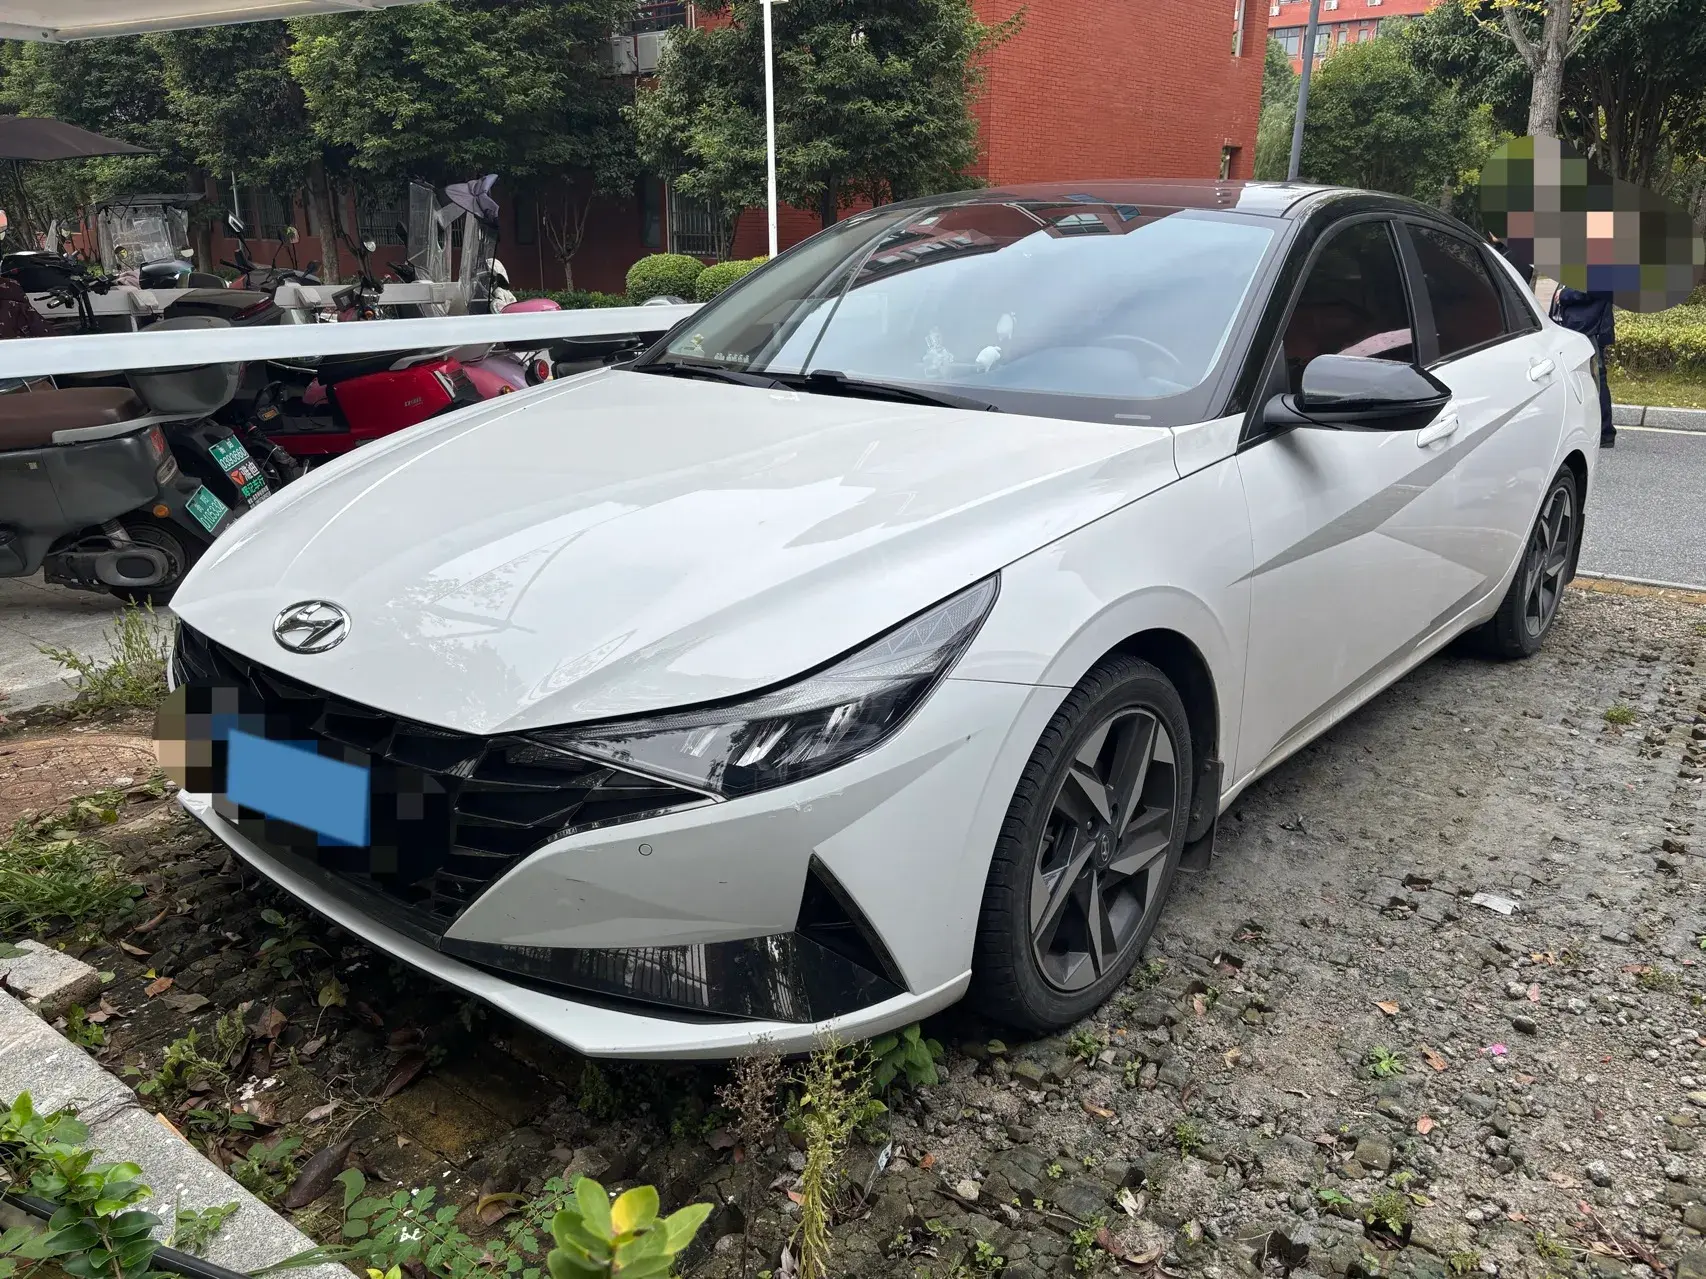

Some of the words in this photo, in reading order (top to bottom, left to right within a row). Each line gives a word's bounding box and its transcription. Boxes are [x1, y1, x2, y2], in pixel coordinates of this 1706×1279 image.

[219, 446, 247, 469] 0393660
[239, 461, 260, 481] 雅迪
[200, 499, 225, 529] 0105332
